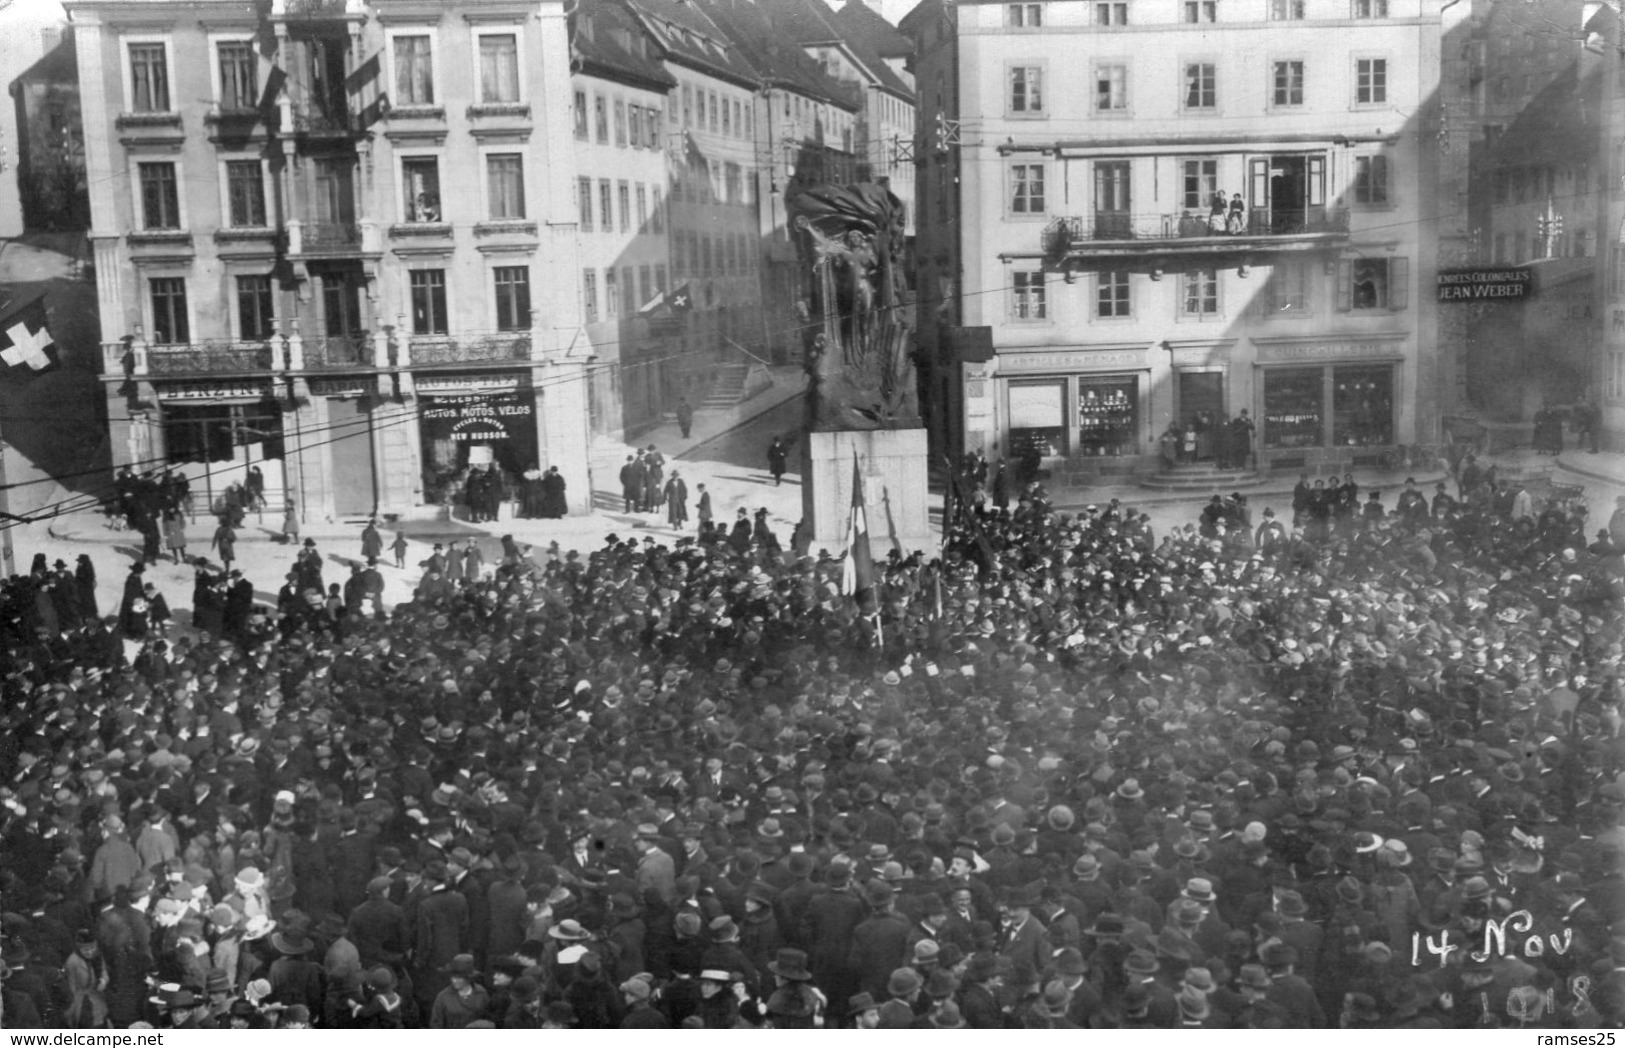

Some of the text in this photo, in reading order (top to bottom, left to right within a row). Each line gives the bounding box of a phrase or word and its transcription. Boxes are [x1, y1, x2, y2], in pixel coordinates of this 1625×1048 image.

[1472, 271, 1529, 283] COLONIALES
[1439, 284, 1523, 299] JEAN WEBER
[450, 433, 468, 441] NEW
[1411, 929, 1458, 968] 14
[1480, 976, 1591, 1027] 1918
